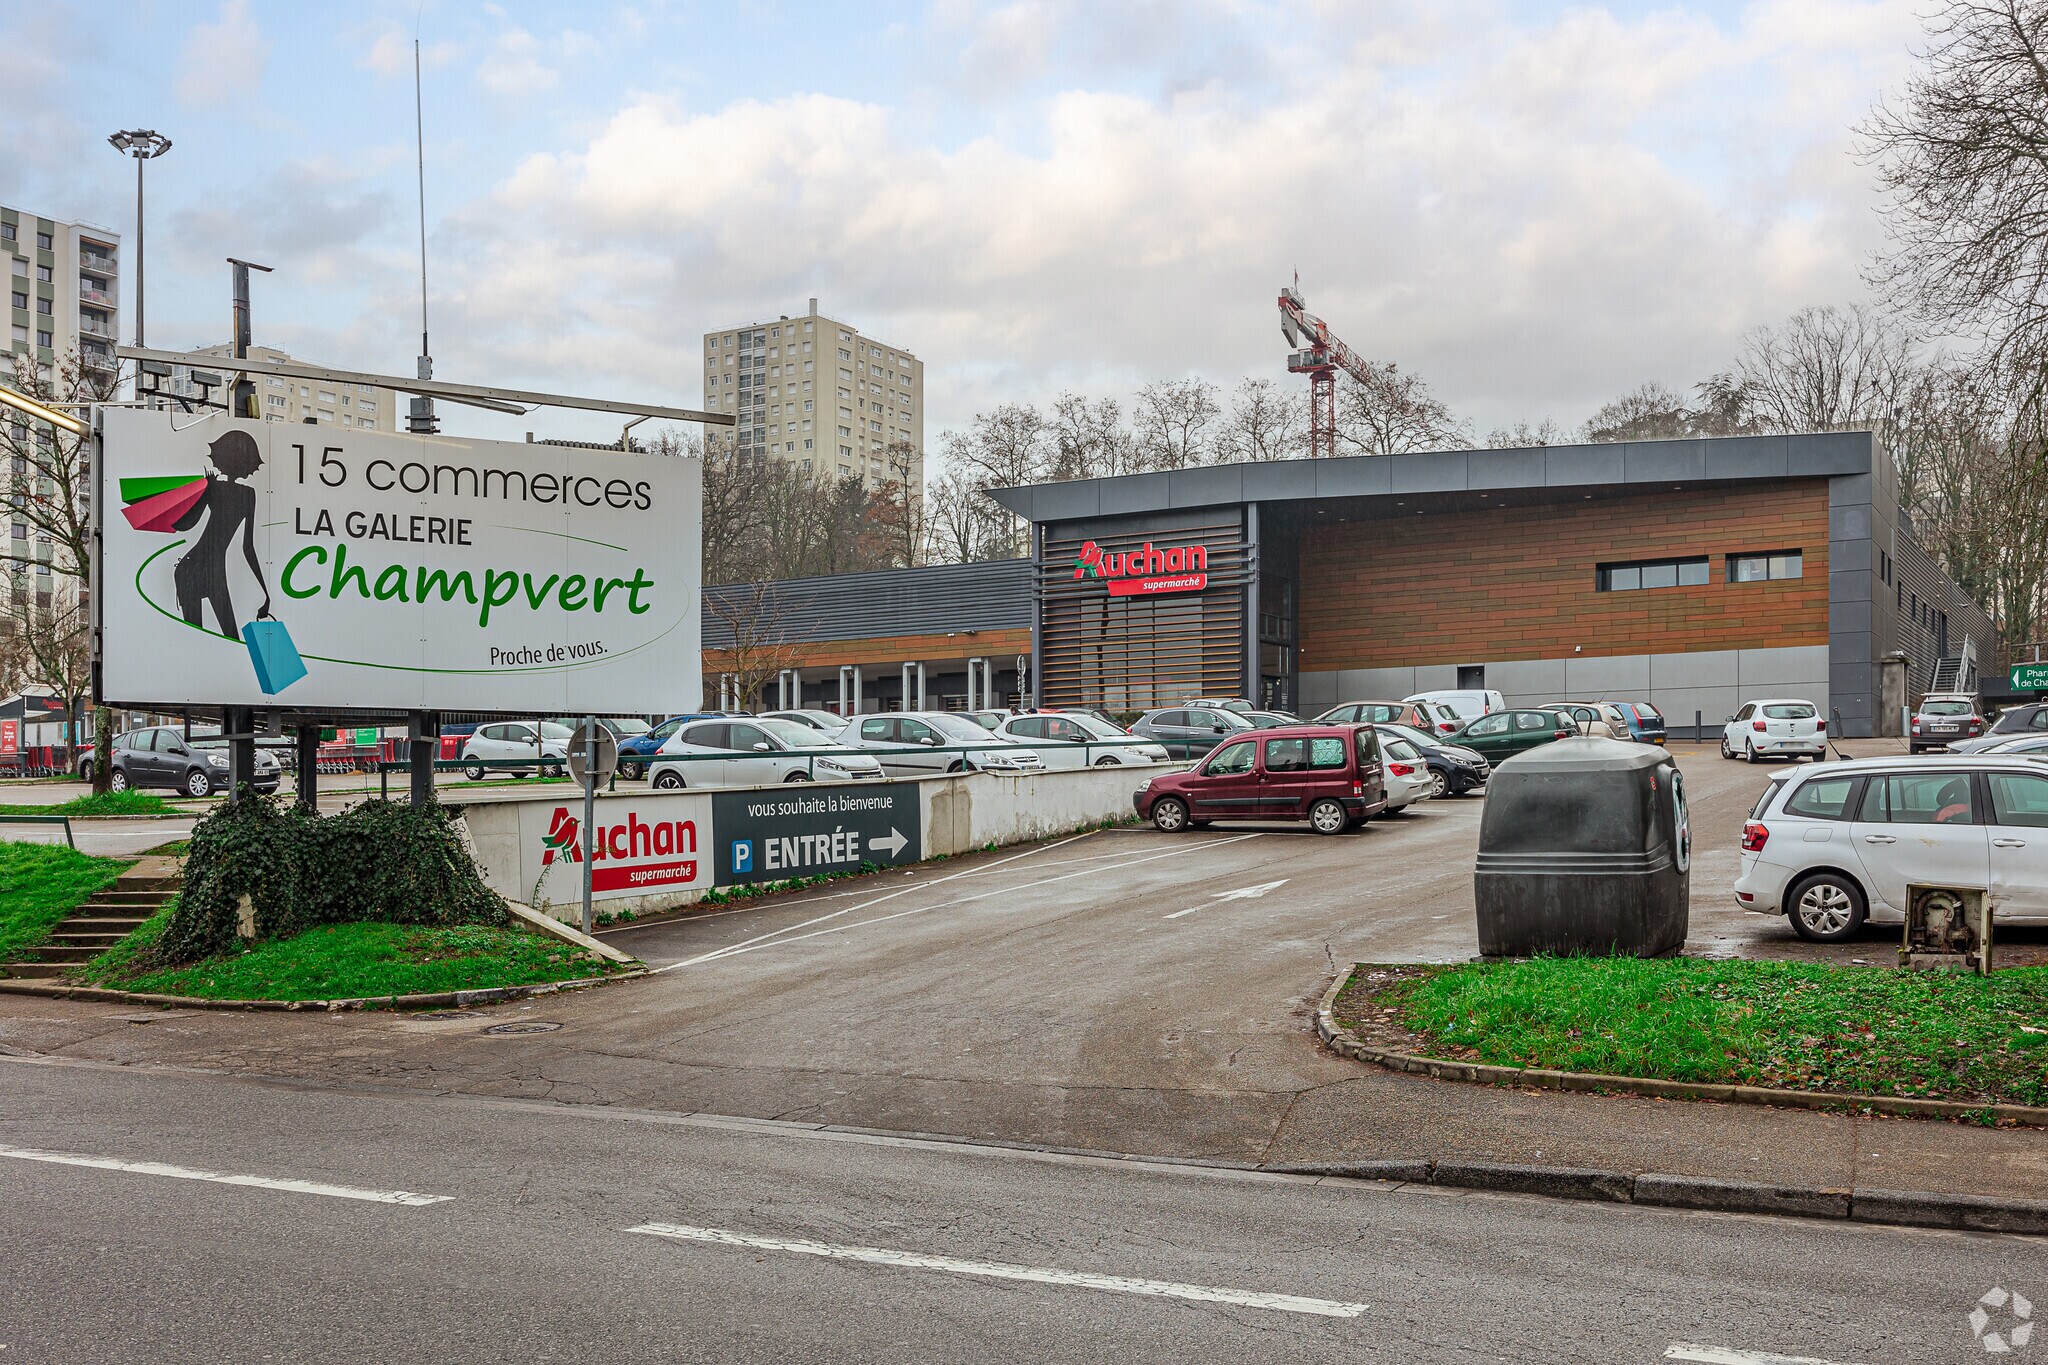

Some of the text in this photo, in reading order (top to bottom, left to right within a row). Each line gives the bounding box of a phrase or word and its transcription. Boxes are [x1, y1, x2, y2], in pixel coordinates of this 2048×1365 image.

[292, 443, 652, 511] 15 commerces
[295, 507, 473, 546] LA GALERIE
[1074, 541, 1208, 578] Auchan
[280, 543, 655, 628] Champvert
[1143, 576, 1200, 591] supermarché
[490, 641, 609, 666] Proche de vous.
[2021, 679, 2032, 687] de
[747, 795, 893, 818] vous souhaite la bienvenue
[542, 807, 697, 866] Auchan
[735, 825, 860, 870] P ENTRÉE
[630, 864, 691, 884] supermarché
